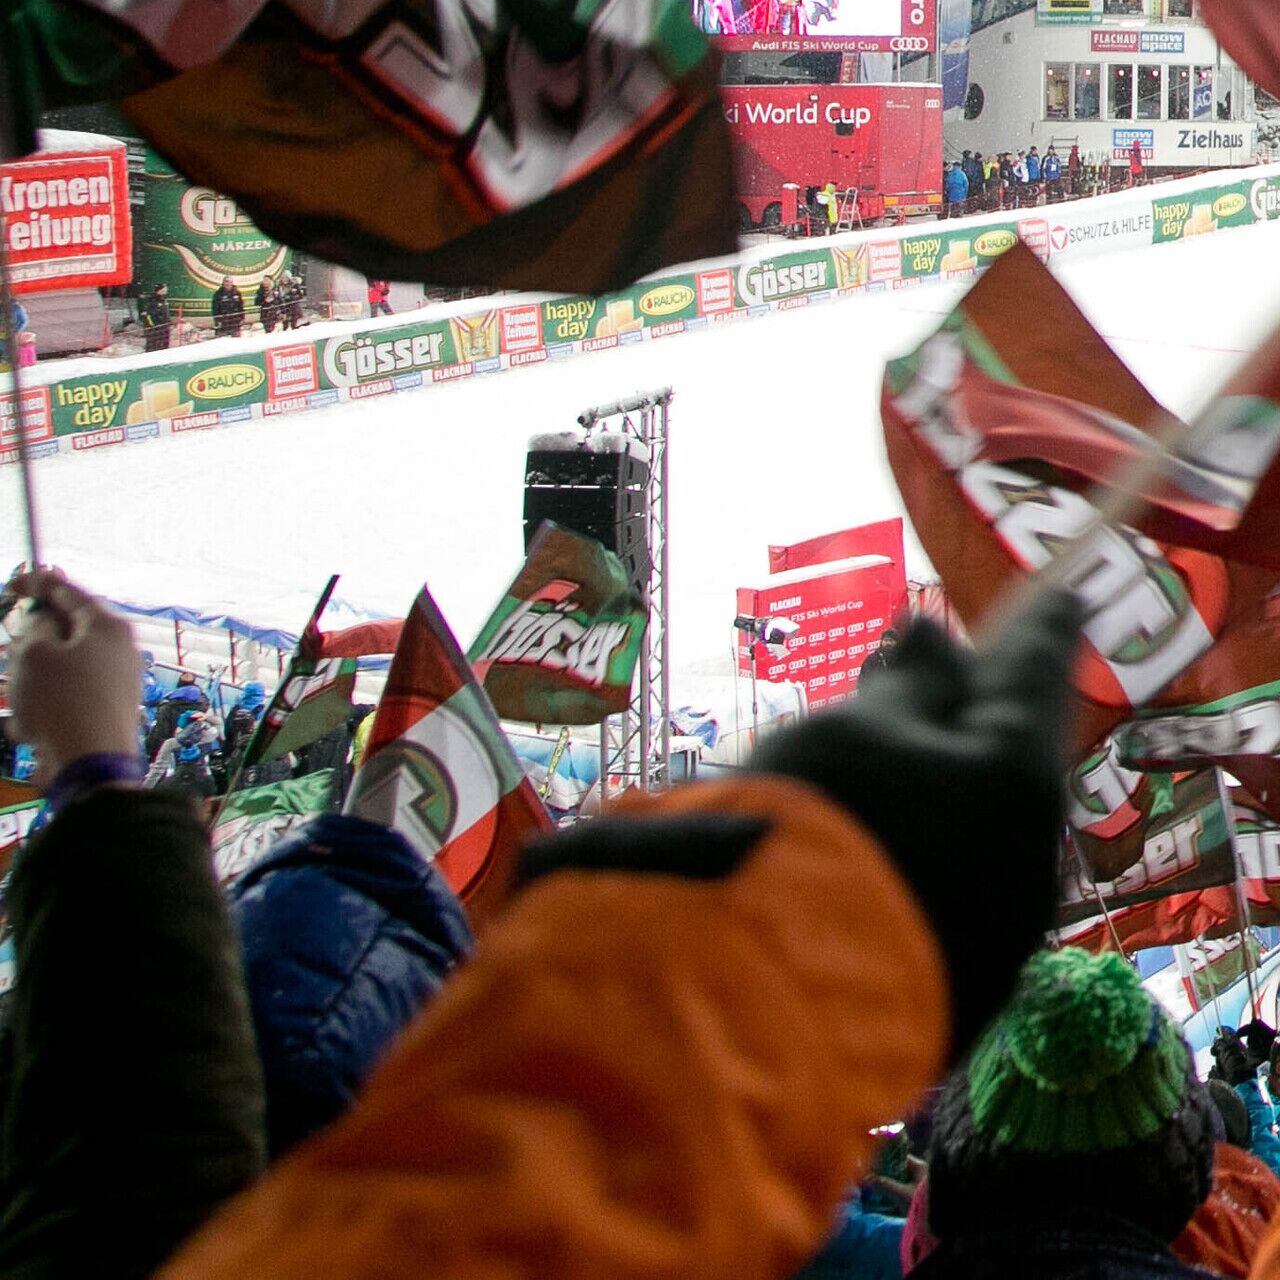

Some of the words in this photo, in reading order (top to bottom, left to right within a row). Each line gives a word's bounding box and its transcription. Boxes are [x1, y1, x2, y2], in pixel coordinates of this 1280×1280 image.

[753, 40, 779, 50] Audi
[782, 40, 800, 50] FIS
[803, 40, 819, 50] Ski
[821, 40, 856, 51] World
[858, 41, 879, 52] Cup
[1094, 34, 1137, 44] FLACHAU
[745, 101, 818, 125] World
[824, 103, 871, 129] Cup
[1178, 130, 1244, 150] Zielhaus
[1114, 150, 1153, 160] FLAAU
[1154, 201, 1190, 221] happy
[4, 212, 112, 251] eitung
[1068, 221, 1109, 245] SCHUTZ
[1111, 220, 1120, 236] &
[1122, 215, 1152, 234] HILFE
[1163, 219, 1183, 238] day
[212, 240, 272, 252] MÄRZEN
[904, 238, 942, 257] happy
[913, 254, 937, 273] day
[738, 260, 828, 308] Gösser
[653, 292, 688, 308] RAUCH
[545, 299, 597, 322] happy
[557, 318, 589, 340] day
[322, 331, 444, 389] Gösser
[207, 372, 256, 391] RAUCH
[57, 380, 129, 408] happy
[74, 401, 119, 428] day
[770, 596, 802, 613] FLACHAU
[807, 609, 819, 620] Ski
[821, 604, 846, 617] World
[848, 599, 864, 613] Cup
